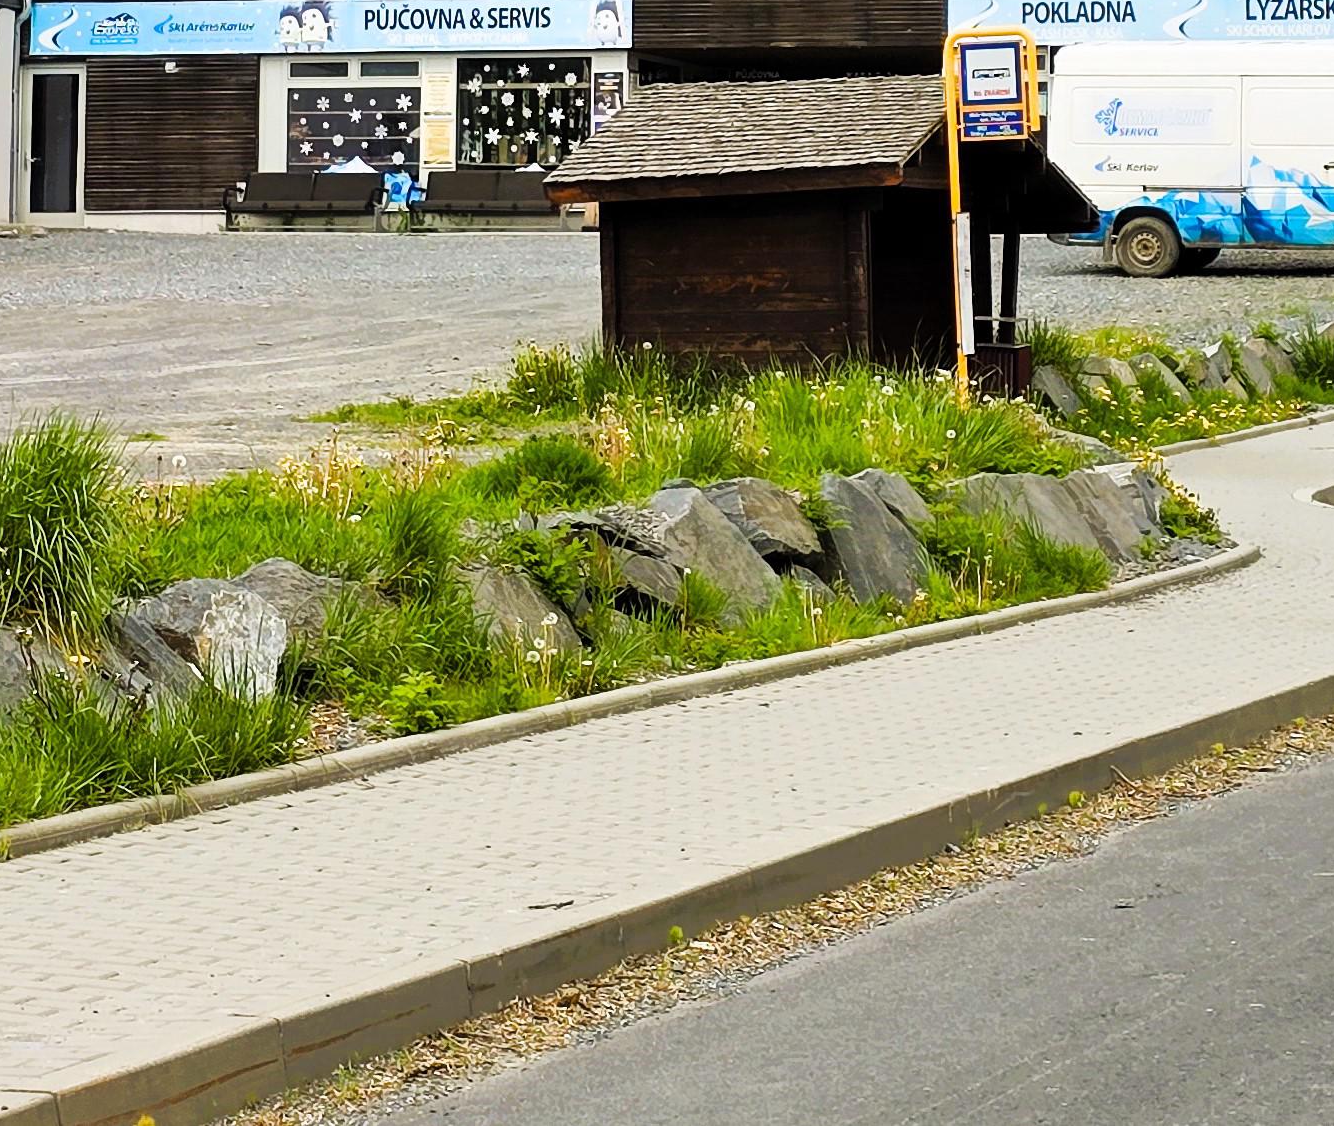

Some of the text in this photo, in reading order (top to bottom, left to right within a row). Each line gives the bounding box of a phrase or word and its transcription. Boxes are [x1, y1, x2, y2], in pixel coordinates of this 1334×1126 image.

[364, 3, 551, 30] PŮJČOVNA & SERVIS
[1022, 0, 1136, 23] POKLADNA
